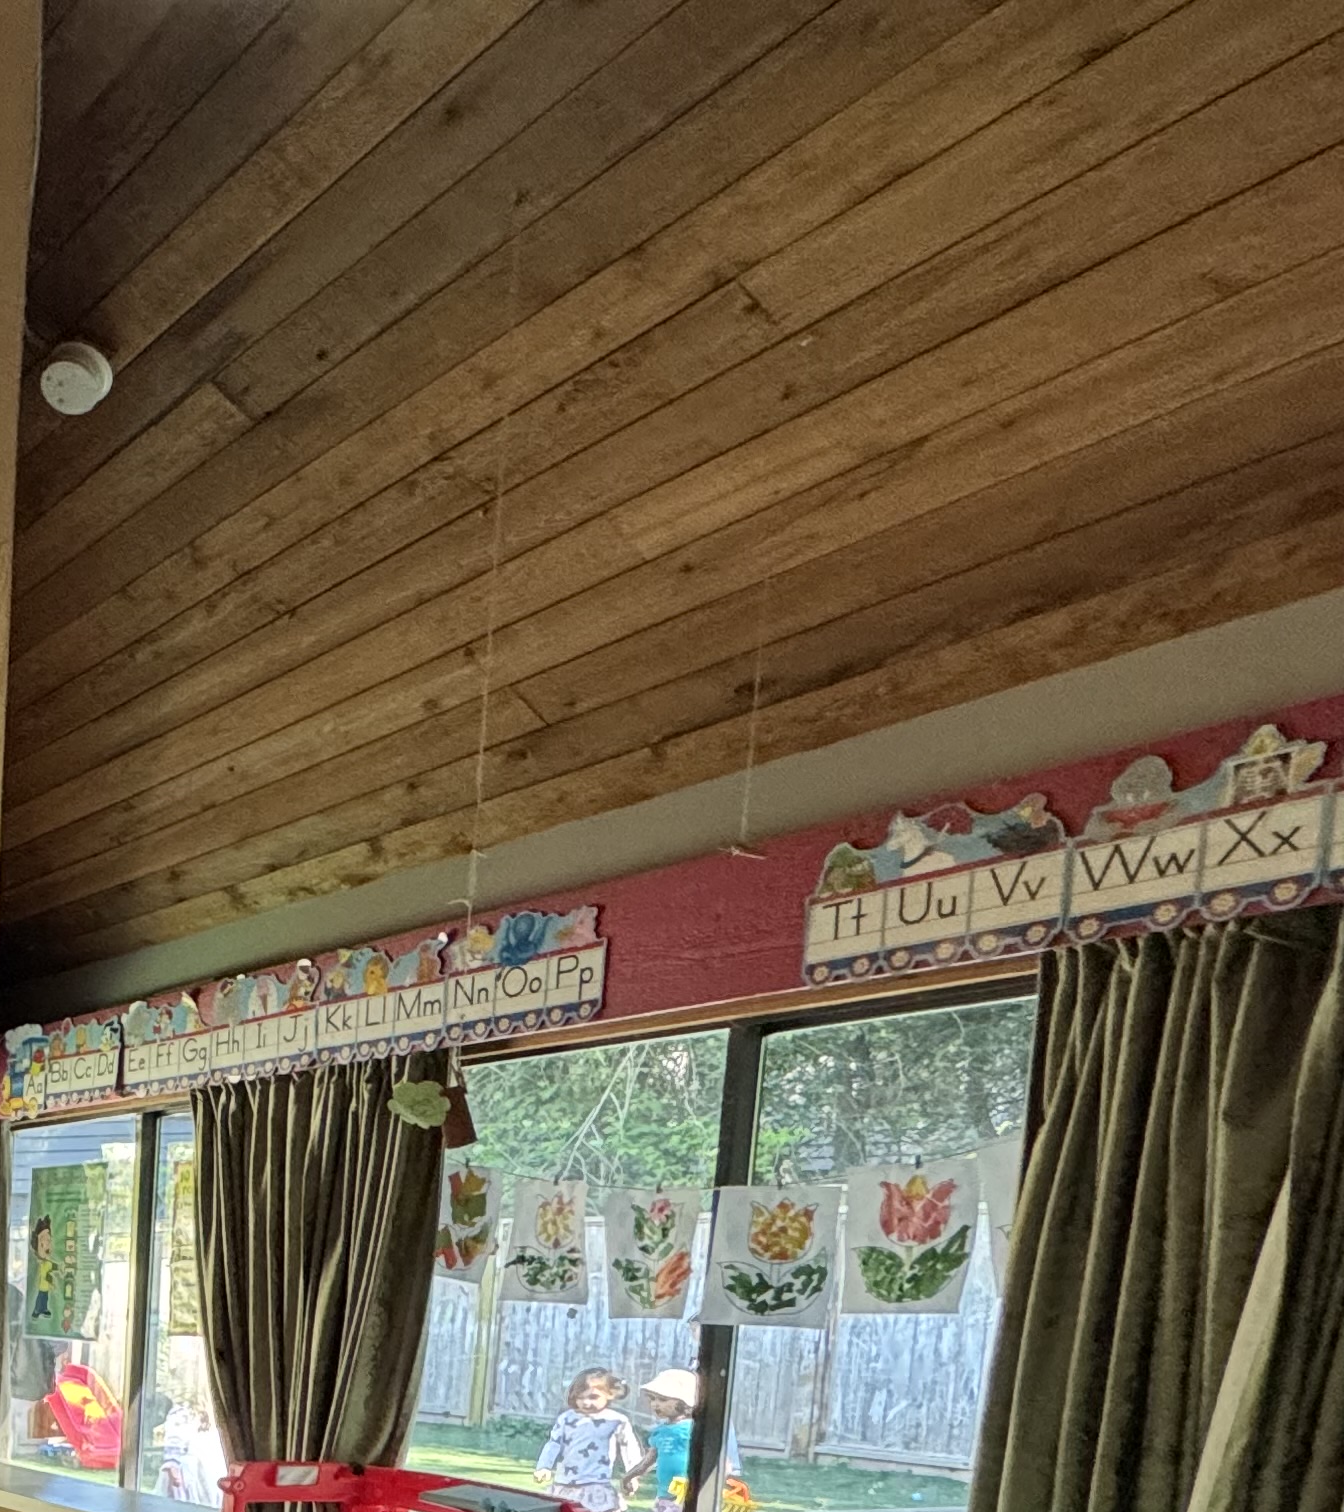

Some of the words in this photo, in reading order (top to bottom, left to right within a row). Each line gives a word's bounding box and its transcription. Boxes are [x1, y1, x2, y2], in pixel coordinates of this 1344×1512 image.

[822, 897, 868, 941] Tt
[898, 881, 957, 925] Uu
[990, 860, 1046, 906] Vv
[1079, 835, 1196, 891] Ww
[1217, 811, 1303, 866] Xx
[26, 1076, 43, 1095] Aa
[50, 1060, 69, 1083] Bb
[73, 1057, 92, 1080] Cc
[97, 1053, 115, 1077] Dd
[128, 1047, 146, 1073] Ee
[155, 1041, 173, 1068] Ff
[182, 1038, 207, 1071] Gg
[215, 1026, 240, 1057] Hh
[255, 1022, 267, 1049] Ii
[283, 1014, 311, 1052] Jj
[325, 1003, 353, 1034] Kk
[365, 996, 387, 1027] Ll
[396, 989, 442, 1020] Mm
[454, 976, 490, 1008] Nn
[501, 965, 543, 998] Oo
[556, 954, 594, 1001] Pp
